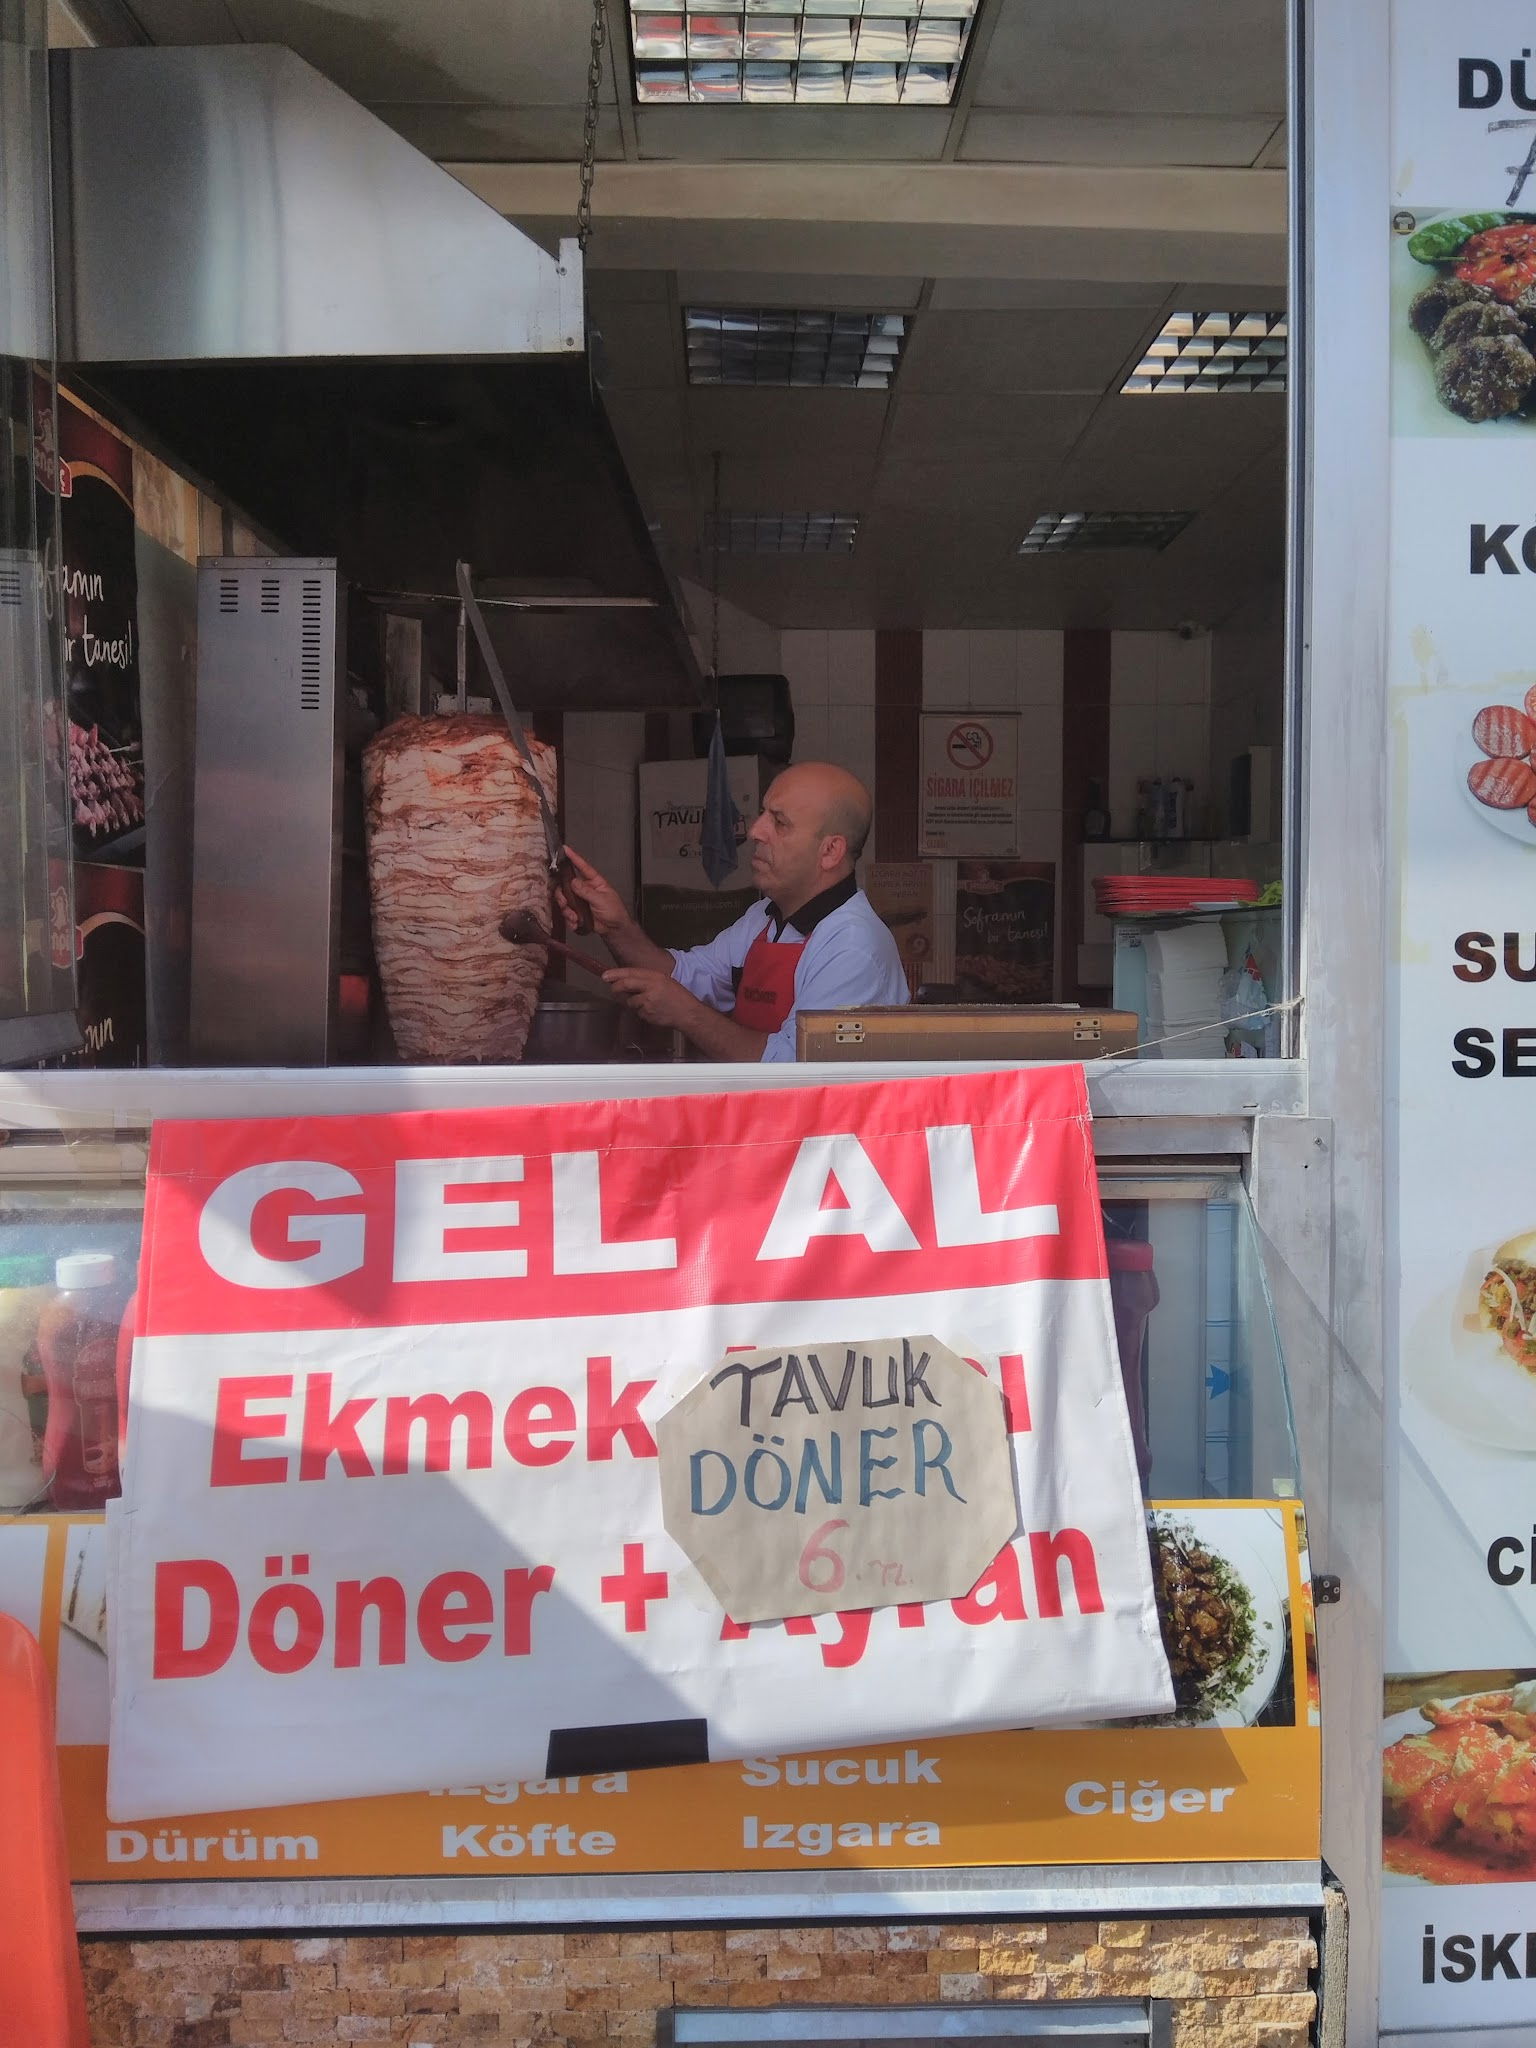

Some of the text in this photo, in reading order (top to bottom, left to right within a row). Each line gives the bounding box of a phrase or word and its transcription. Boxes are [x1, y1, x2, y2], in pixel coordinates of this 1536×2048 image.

[1469, 512, 1536, 575] K
[82, 614, 133, 669] tanesi!
[653, 808, 705, 829] TAVU
[199, 1124, 1060, 1290] GEL AL
[709, 1338, 942, 1428] TAVUK
[209, 1356, 658, 1488] Ekmek
[689, 1418, 967, 1515] DÖNER
[153, 1553, 556, 1680] Döner
[428, 1771, 628, 1805] gara
[740, 1749, 942, 1787] Sucuk
[1064, 1780, 1235, 1823] Ciğer
[106, 1829, 319, 1863] Dürüm
[442, 1823, 617, 1858] Köfte
[742, 1815, 941, 1856] Izgara
[1422, 1924, 1536, 1984] İSK
